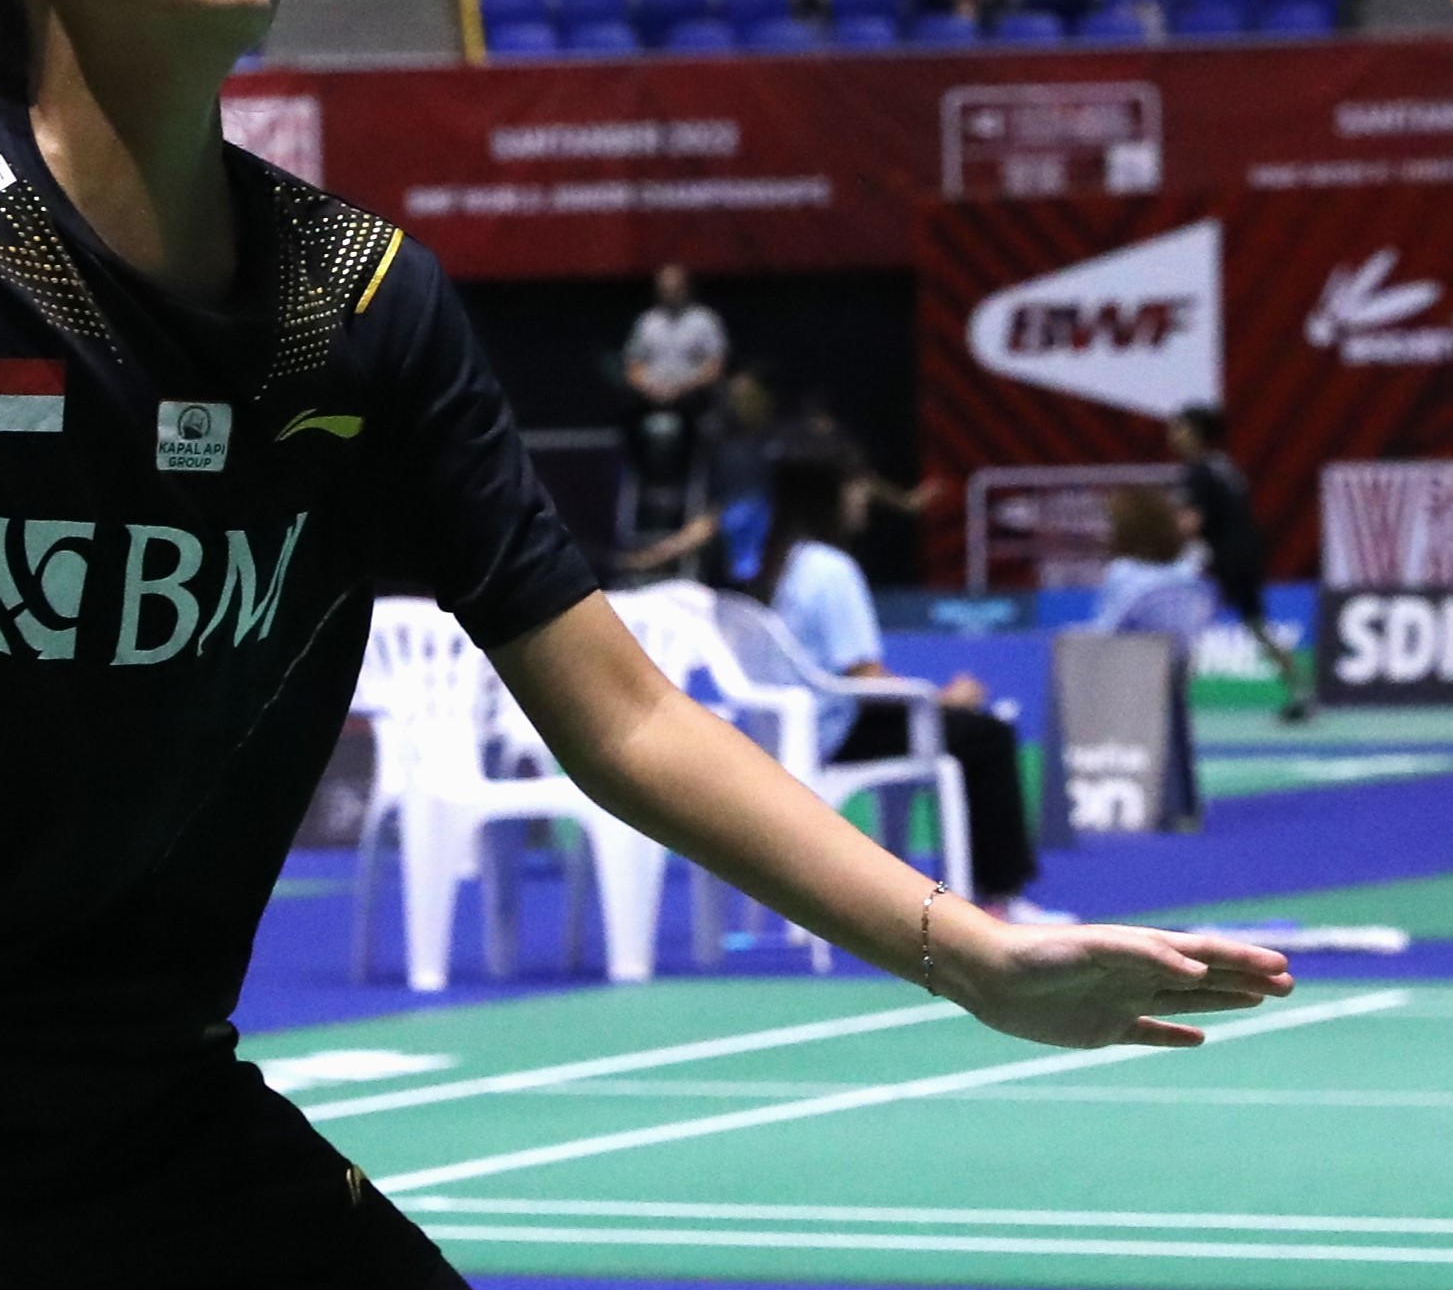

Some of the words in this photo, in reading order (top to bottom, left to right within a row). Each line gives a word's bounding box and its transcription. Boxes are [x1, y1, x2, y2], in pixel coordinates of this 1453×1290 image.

[1005, 295, 1192, 354] BWF
[158, 442, 202, 455] KAPAL
[202, 443, 226, 456] API
[168, 456, 212, 468] GROUP
